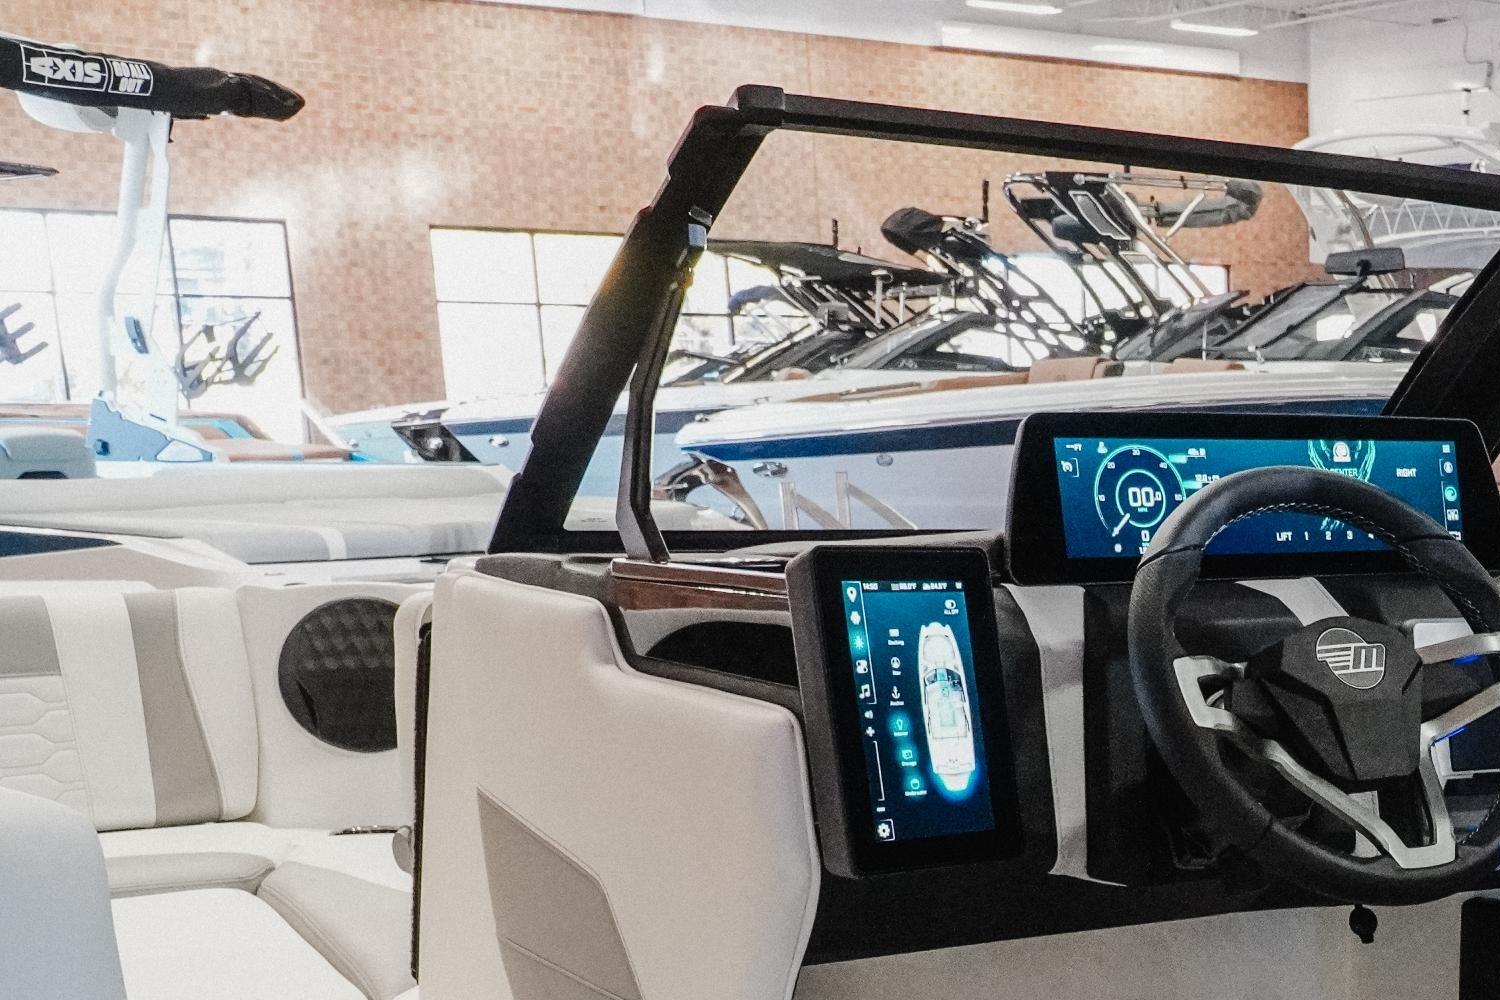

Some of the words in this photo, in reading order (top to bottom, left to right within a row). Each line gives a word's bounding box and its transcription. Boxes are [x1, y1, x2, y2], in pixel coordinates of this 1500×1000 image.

[30, 56, 102, 84] AXIS
[112, 61, 129, 77] GO
[128, 63, 150, 80] ALL
[118, 77, 145, 93] OUT
[1396, 468, 1416, 477] RIGHT
[1276, 532, 1293, 542] LIFT
[1325, 531, 1332, 540] 2
[1346, 530, 1353, 540] 3
